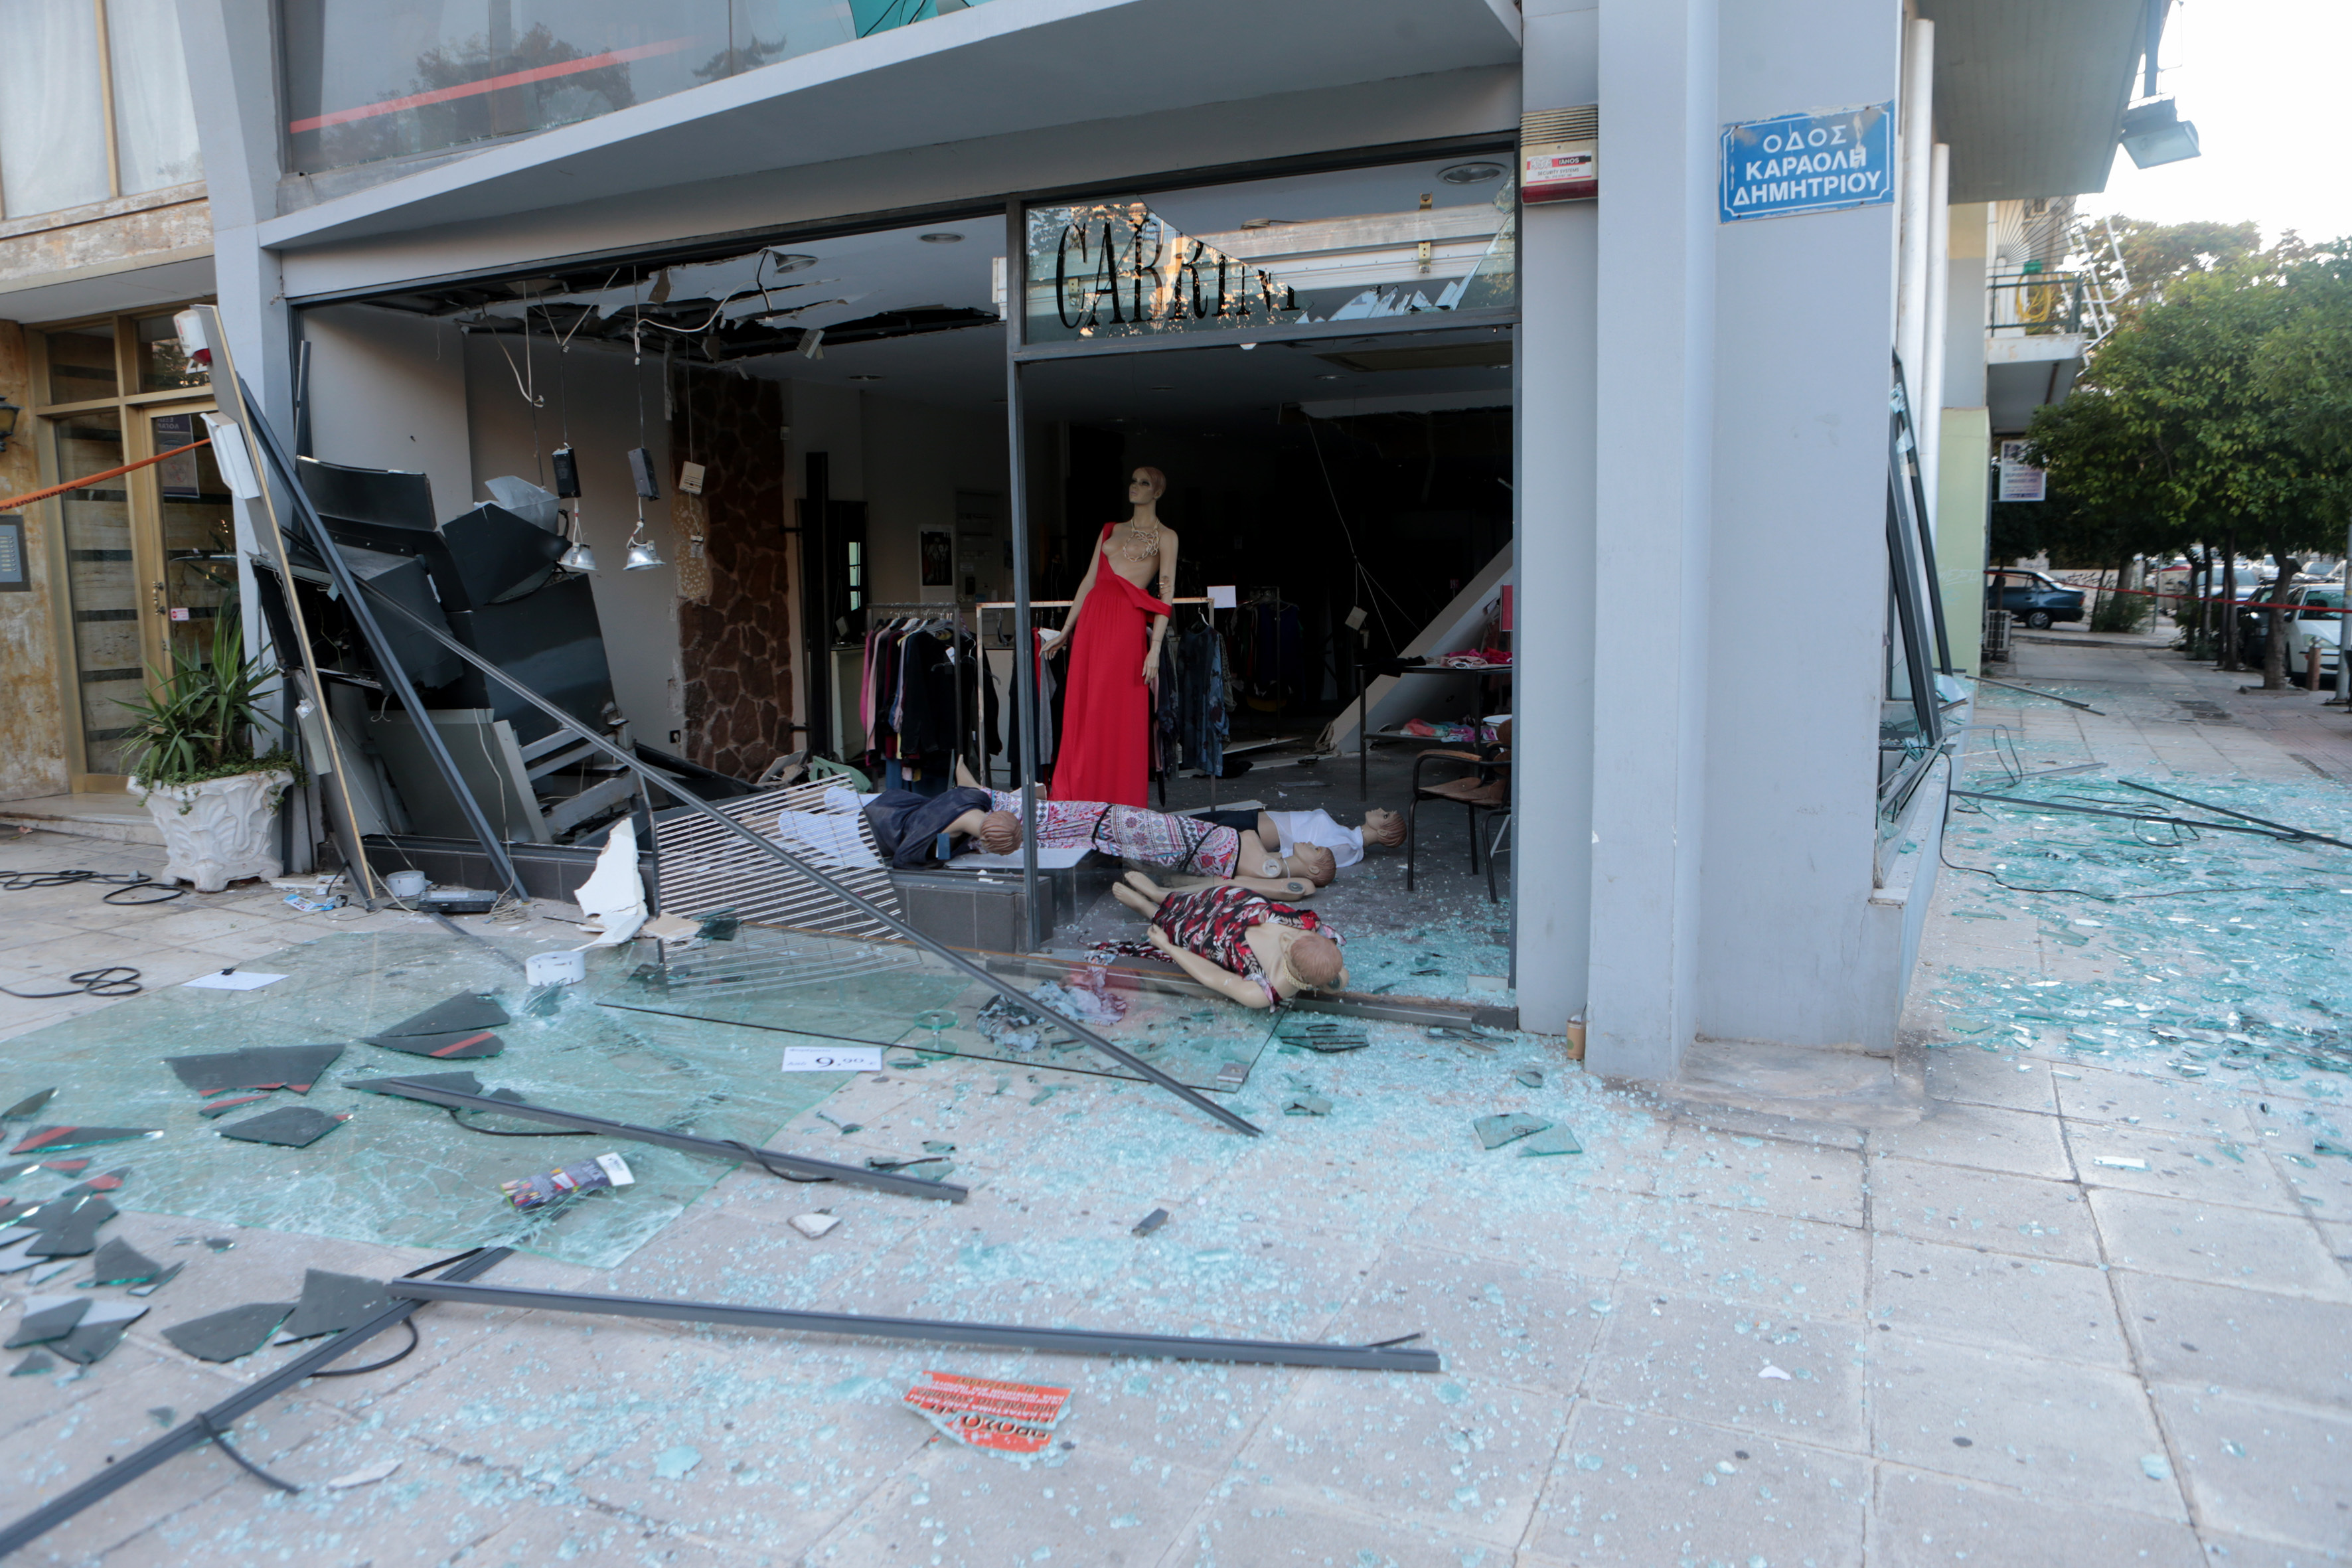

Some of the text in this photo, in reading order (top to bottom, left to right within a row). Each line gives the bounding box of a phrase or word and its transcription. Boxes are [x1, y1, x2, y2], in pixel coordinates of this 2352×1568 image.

[1763, 124, 1847, 153] ΟΔΟΣ
[1745, 147, 1867, 181] ΚΑΡΑΟΛΗ
[1732, 170, 1882, 207] ΔΗΜΗΤΡΙΟΥ
